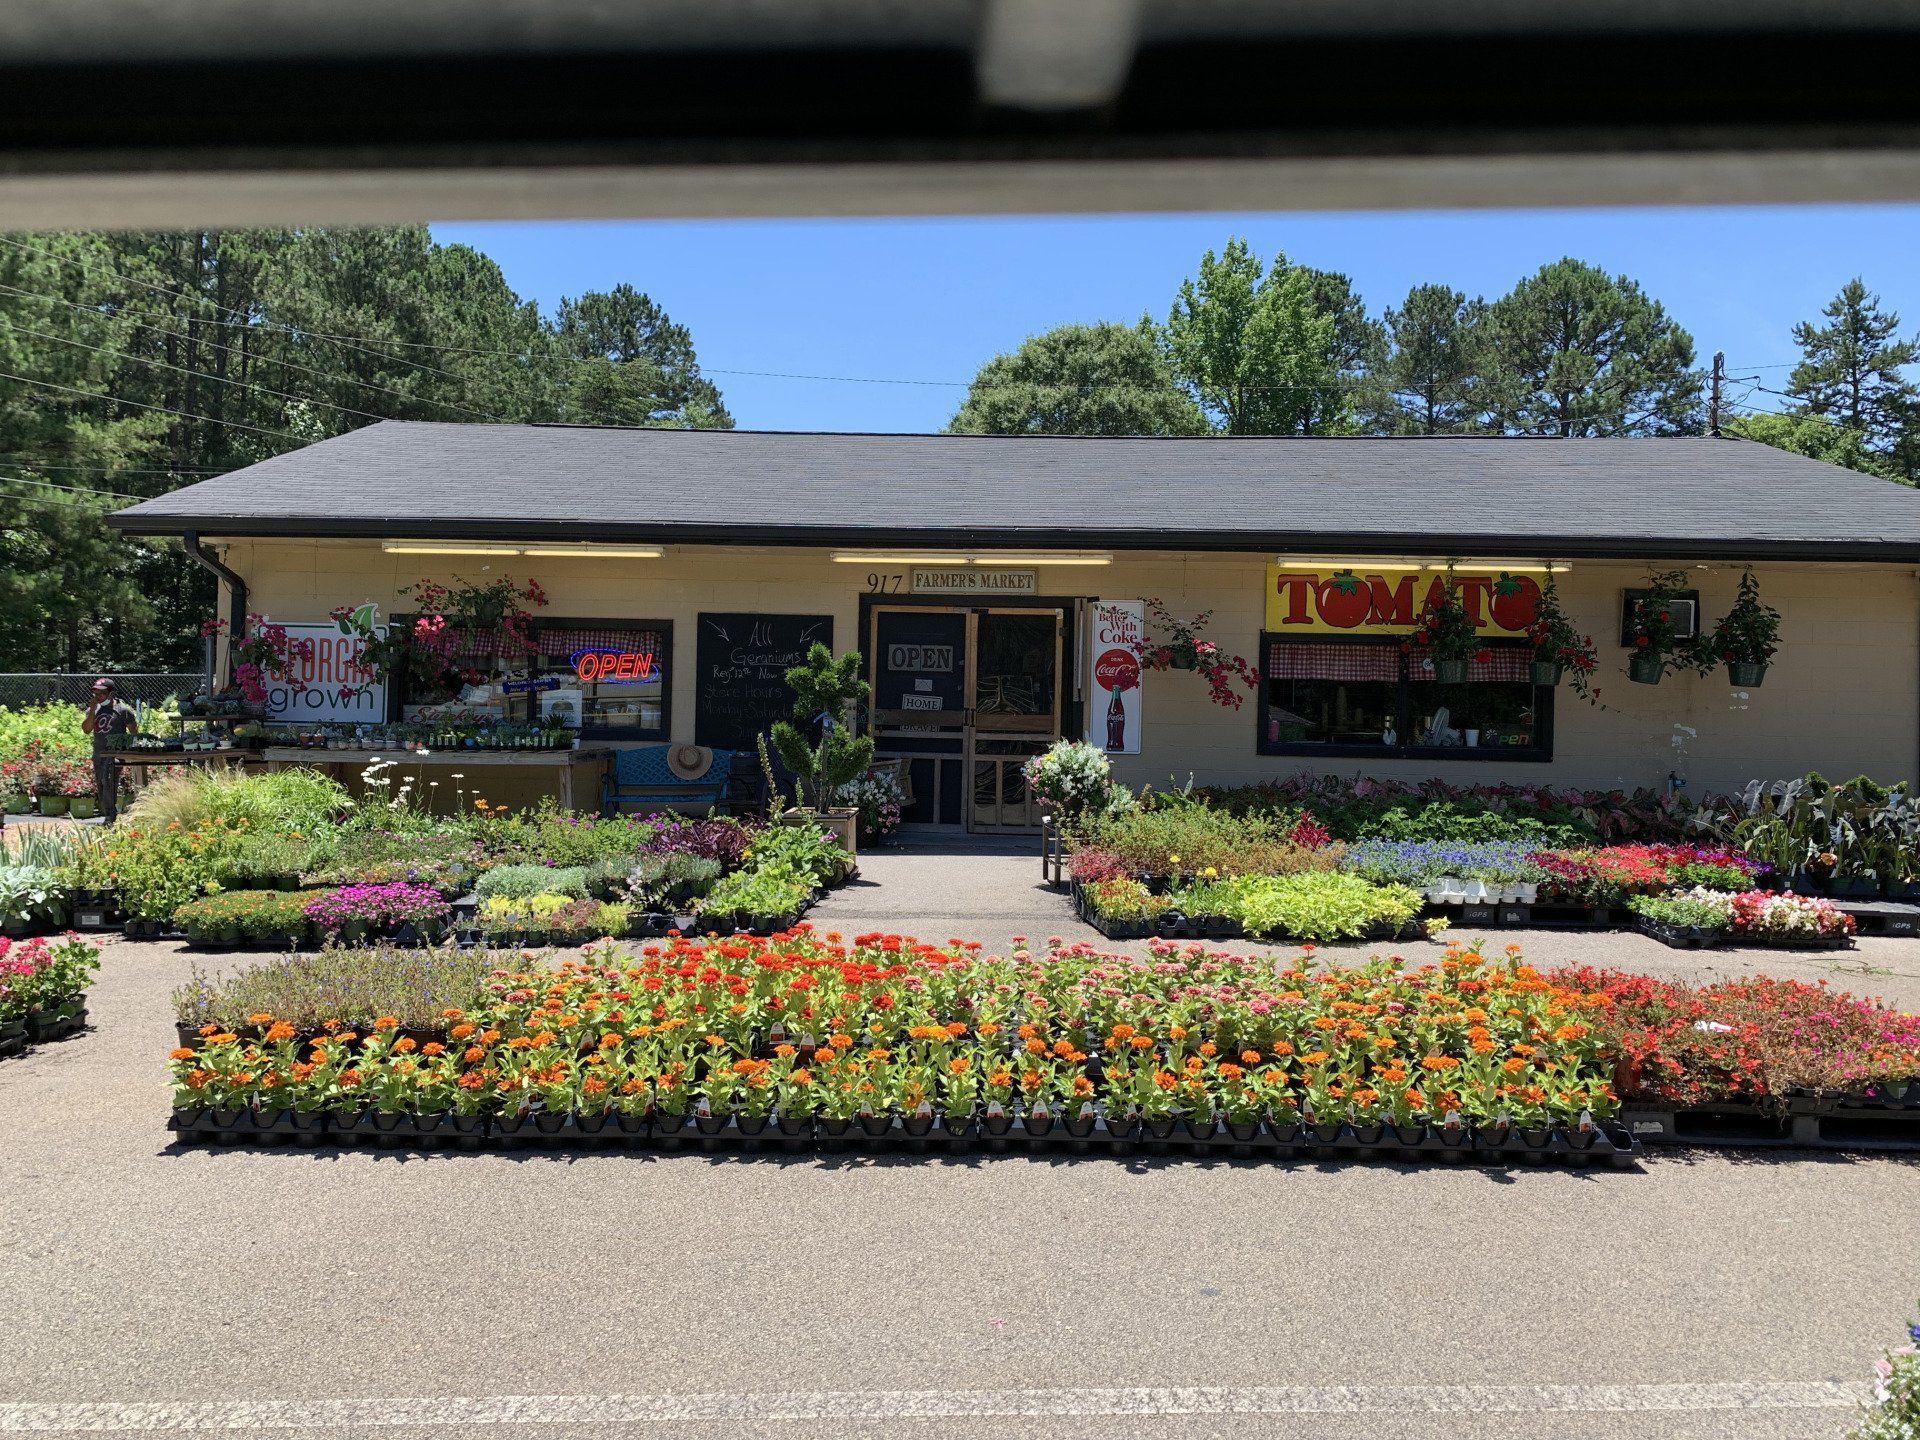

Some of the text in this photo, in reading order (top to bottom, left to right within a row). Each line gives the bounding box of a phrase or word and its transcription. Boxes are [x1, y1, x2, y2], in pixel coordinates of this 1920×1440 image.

[867, 573, 903, 594] 917
[915, 573, 1034, 589] FARMER'S MARKET
[1277, 570, 1543, 632] TOMATO
[1099, 613, 1127, 622] Better
[1110, 621, 1137, 632] With
[748, 620, 773, 647] All
[1099, 628, 1138, 644] Coke
[730, 647, 802, 666] Geraniums
[891, 647, 952, 669] OPEN
[578, 653, 653, 681] OPEN
[269, 687, 374, 713] grown
[905, 697, 939, 710] HOME
[1892, 922, 1911, 930] iGPS
